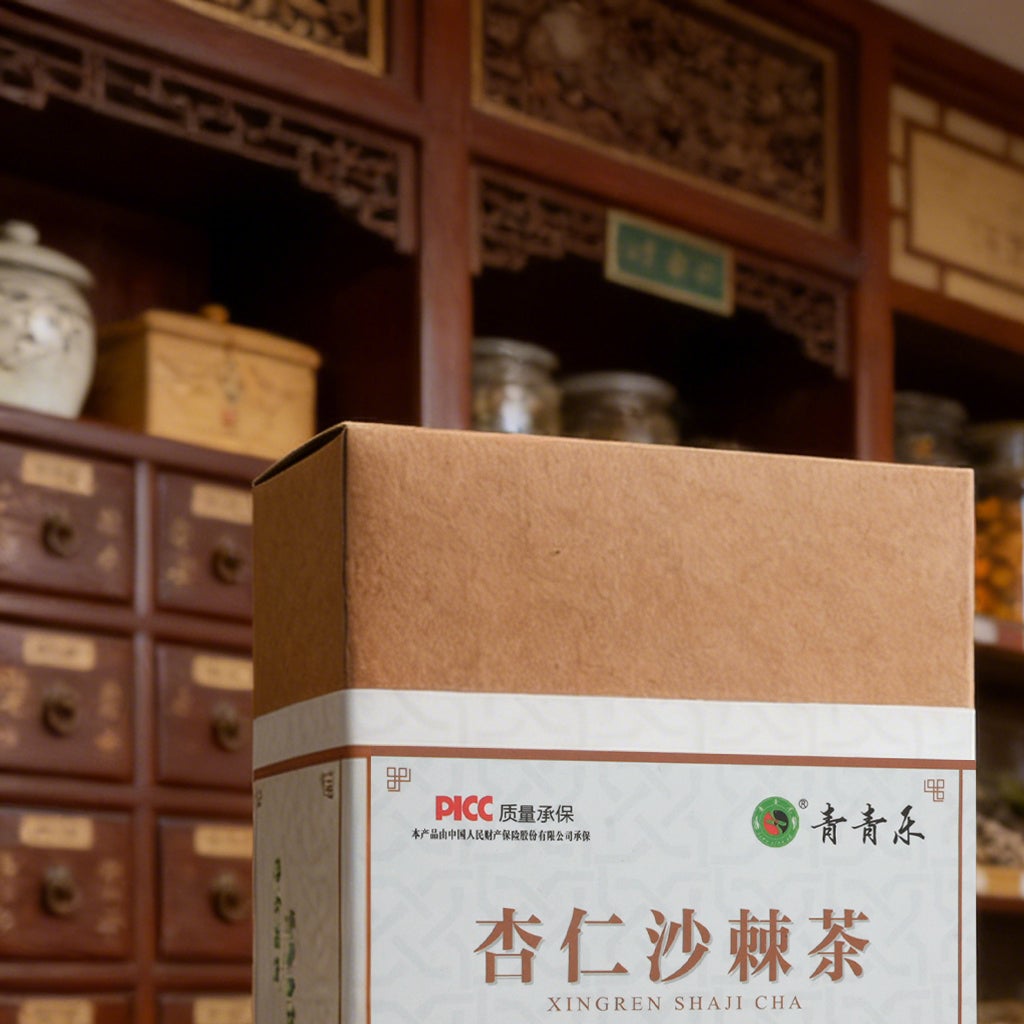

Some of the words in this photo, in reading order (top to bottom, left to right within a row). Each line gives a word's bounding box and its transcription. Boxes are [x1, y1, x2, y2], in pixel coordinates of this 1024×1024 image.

[435, 795, 493, 822] PICC
[498, 803, 575, 824] 质量承保
[811, 802, 926, 846] 青青乐
[411, 828, 591, 842] 本产品由中国人民财产保险股份有限公司承保
[473, 907, 871, 984] 杏仁沙棘茶
[547, 996, 661, 1012] XINGREN
[674, 995, 743, 1011] SHAJI
[754, 995, 803, 1010] CHA
